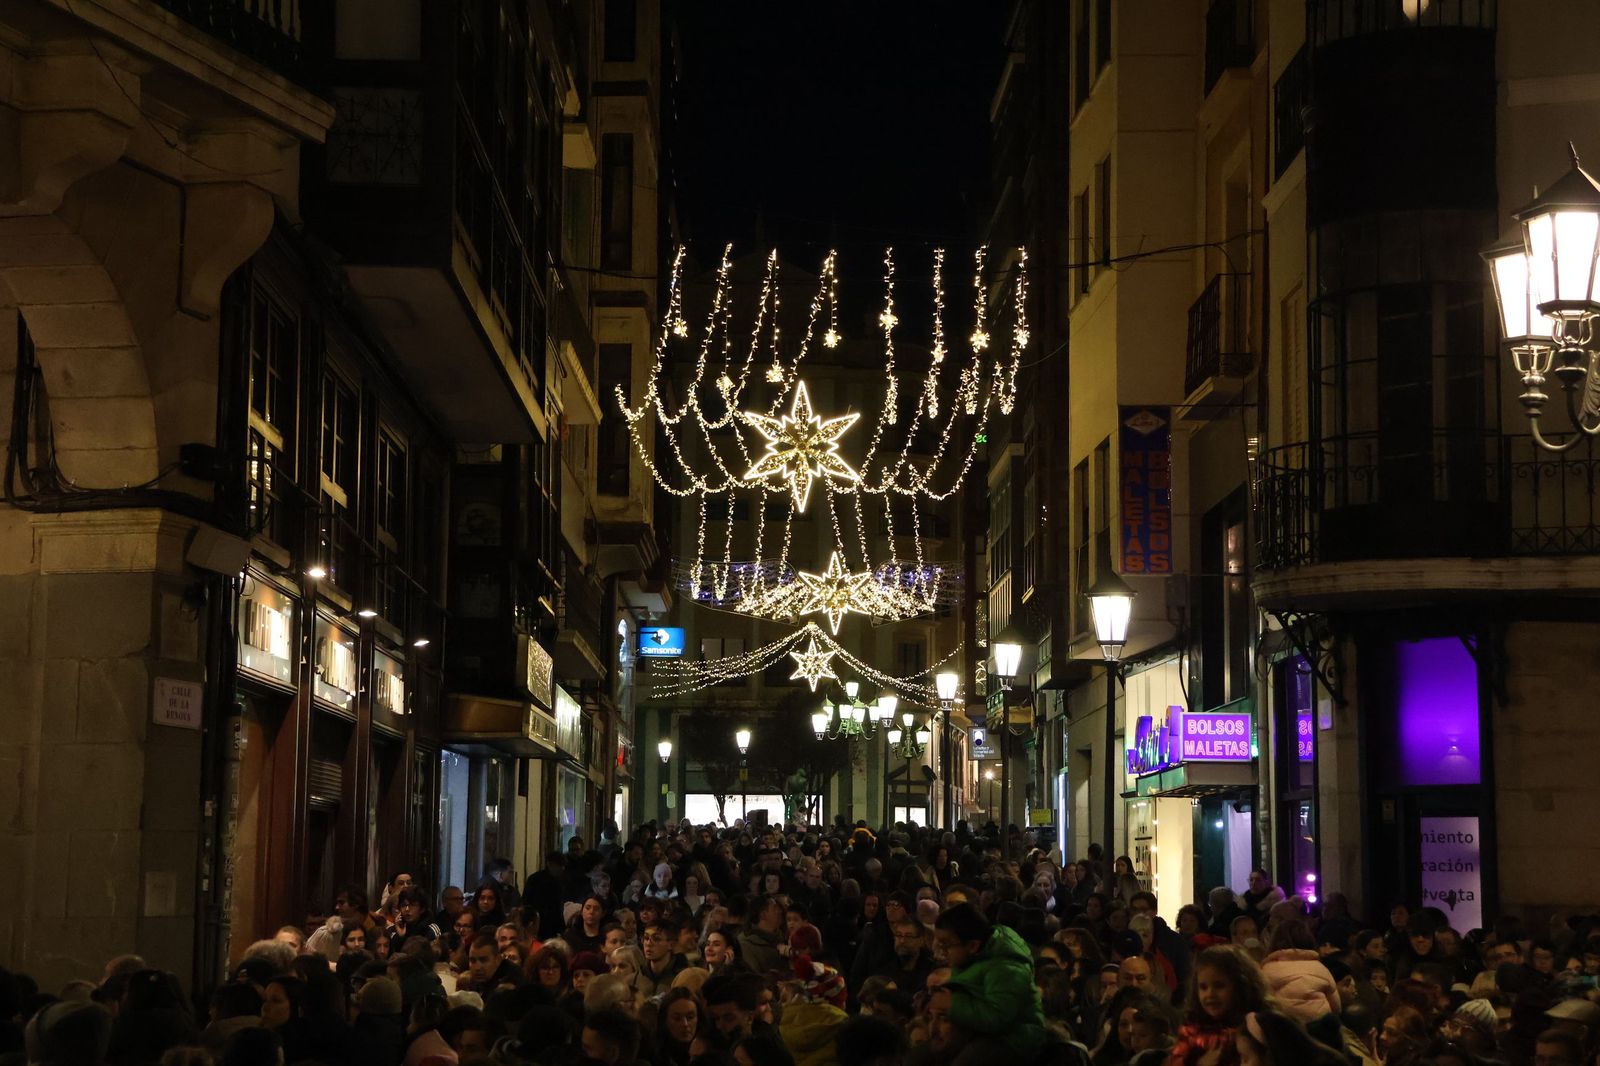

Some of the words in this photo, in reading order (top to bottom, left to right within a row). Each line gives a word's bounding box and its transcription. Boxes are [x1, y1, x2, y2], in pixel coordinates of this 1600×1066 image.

[1124, 451, 1144, 571] MALETAS
[1149, 451, 1168, 571] BOLSOS
[641, 647, 682, 655] Samsonite
[172, 686, 192, 697] CALLE
[1187, 719, 1245, 735] BOLSOS
[1184, 740, 1249, 756] MALETAS
